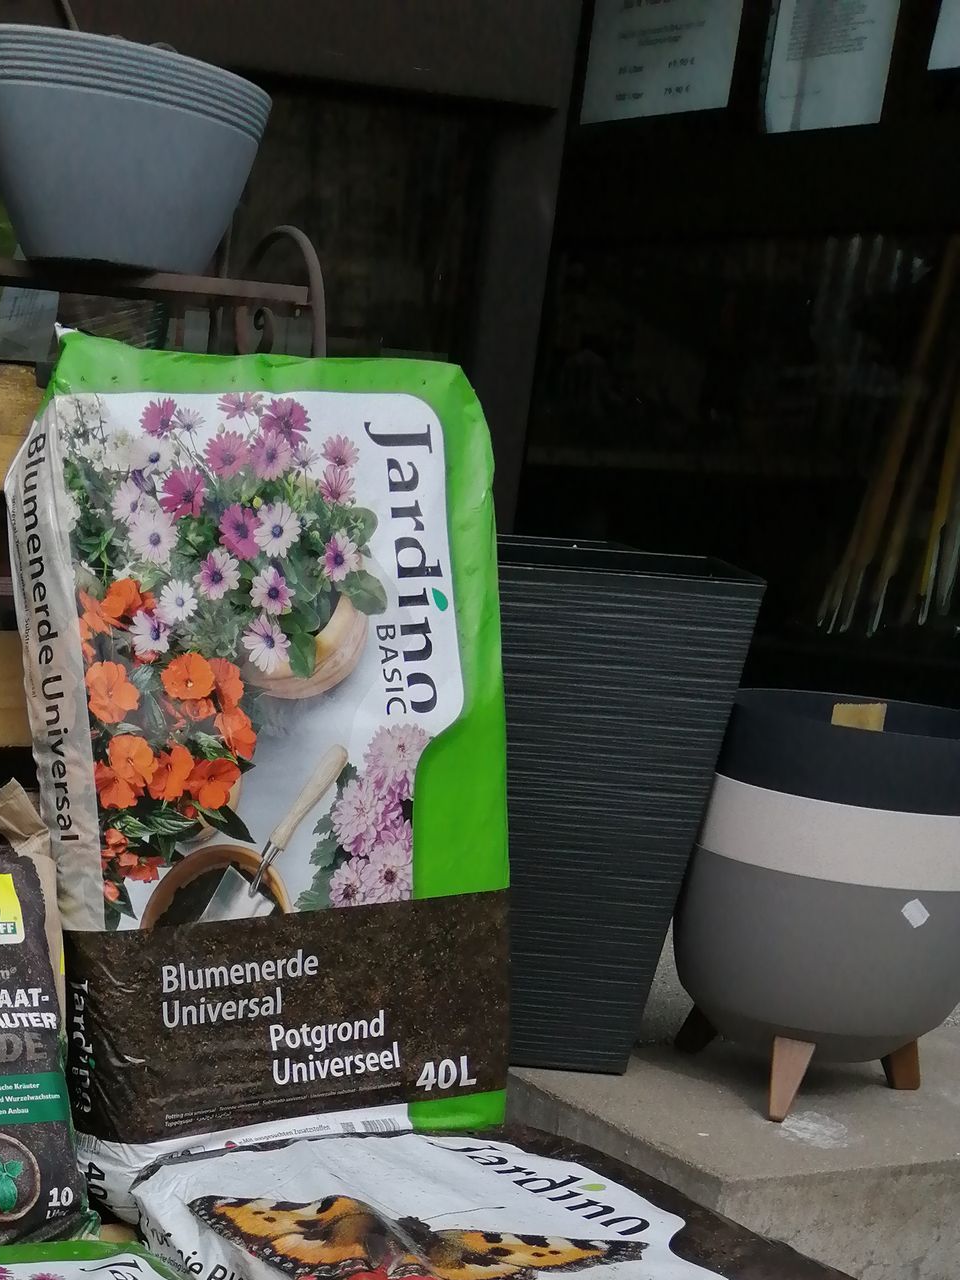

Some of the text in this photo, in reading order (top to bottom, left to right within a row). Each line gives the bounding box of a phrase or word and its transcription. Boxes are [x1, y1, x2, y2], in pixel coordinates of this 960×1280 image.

[364, 421, 449, 714] Jardino
[23, 432, 58, 665] Blumenerde
[42, 674, 80, 842] Universal
[377, 623, 407, 716] BASIC
[161, 948, 320, 994] Blumenerde
[161, 989, 283, 1029] Universal
[269, 1010, 386, 1054] Potgrond
[271, 1041, 401, 1086] Universeel
[416, 1055, 478, 1092] 40L
[4, 1092, 61, 1104] Wurzelwachstum
[14, 1081, 40, 1091] Kräuter
[7, 1106, 29, 1116] Anbau
[48, 1186, 74, 1207] 10
[426, 1141, 650, 1236] Jardino
